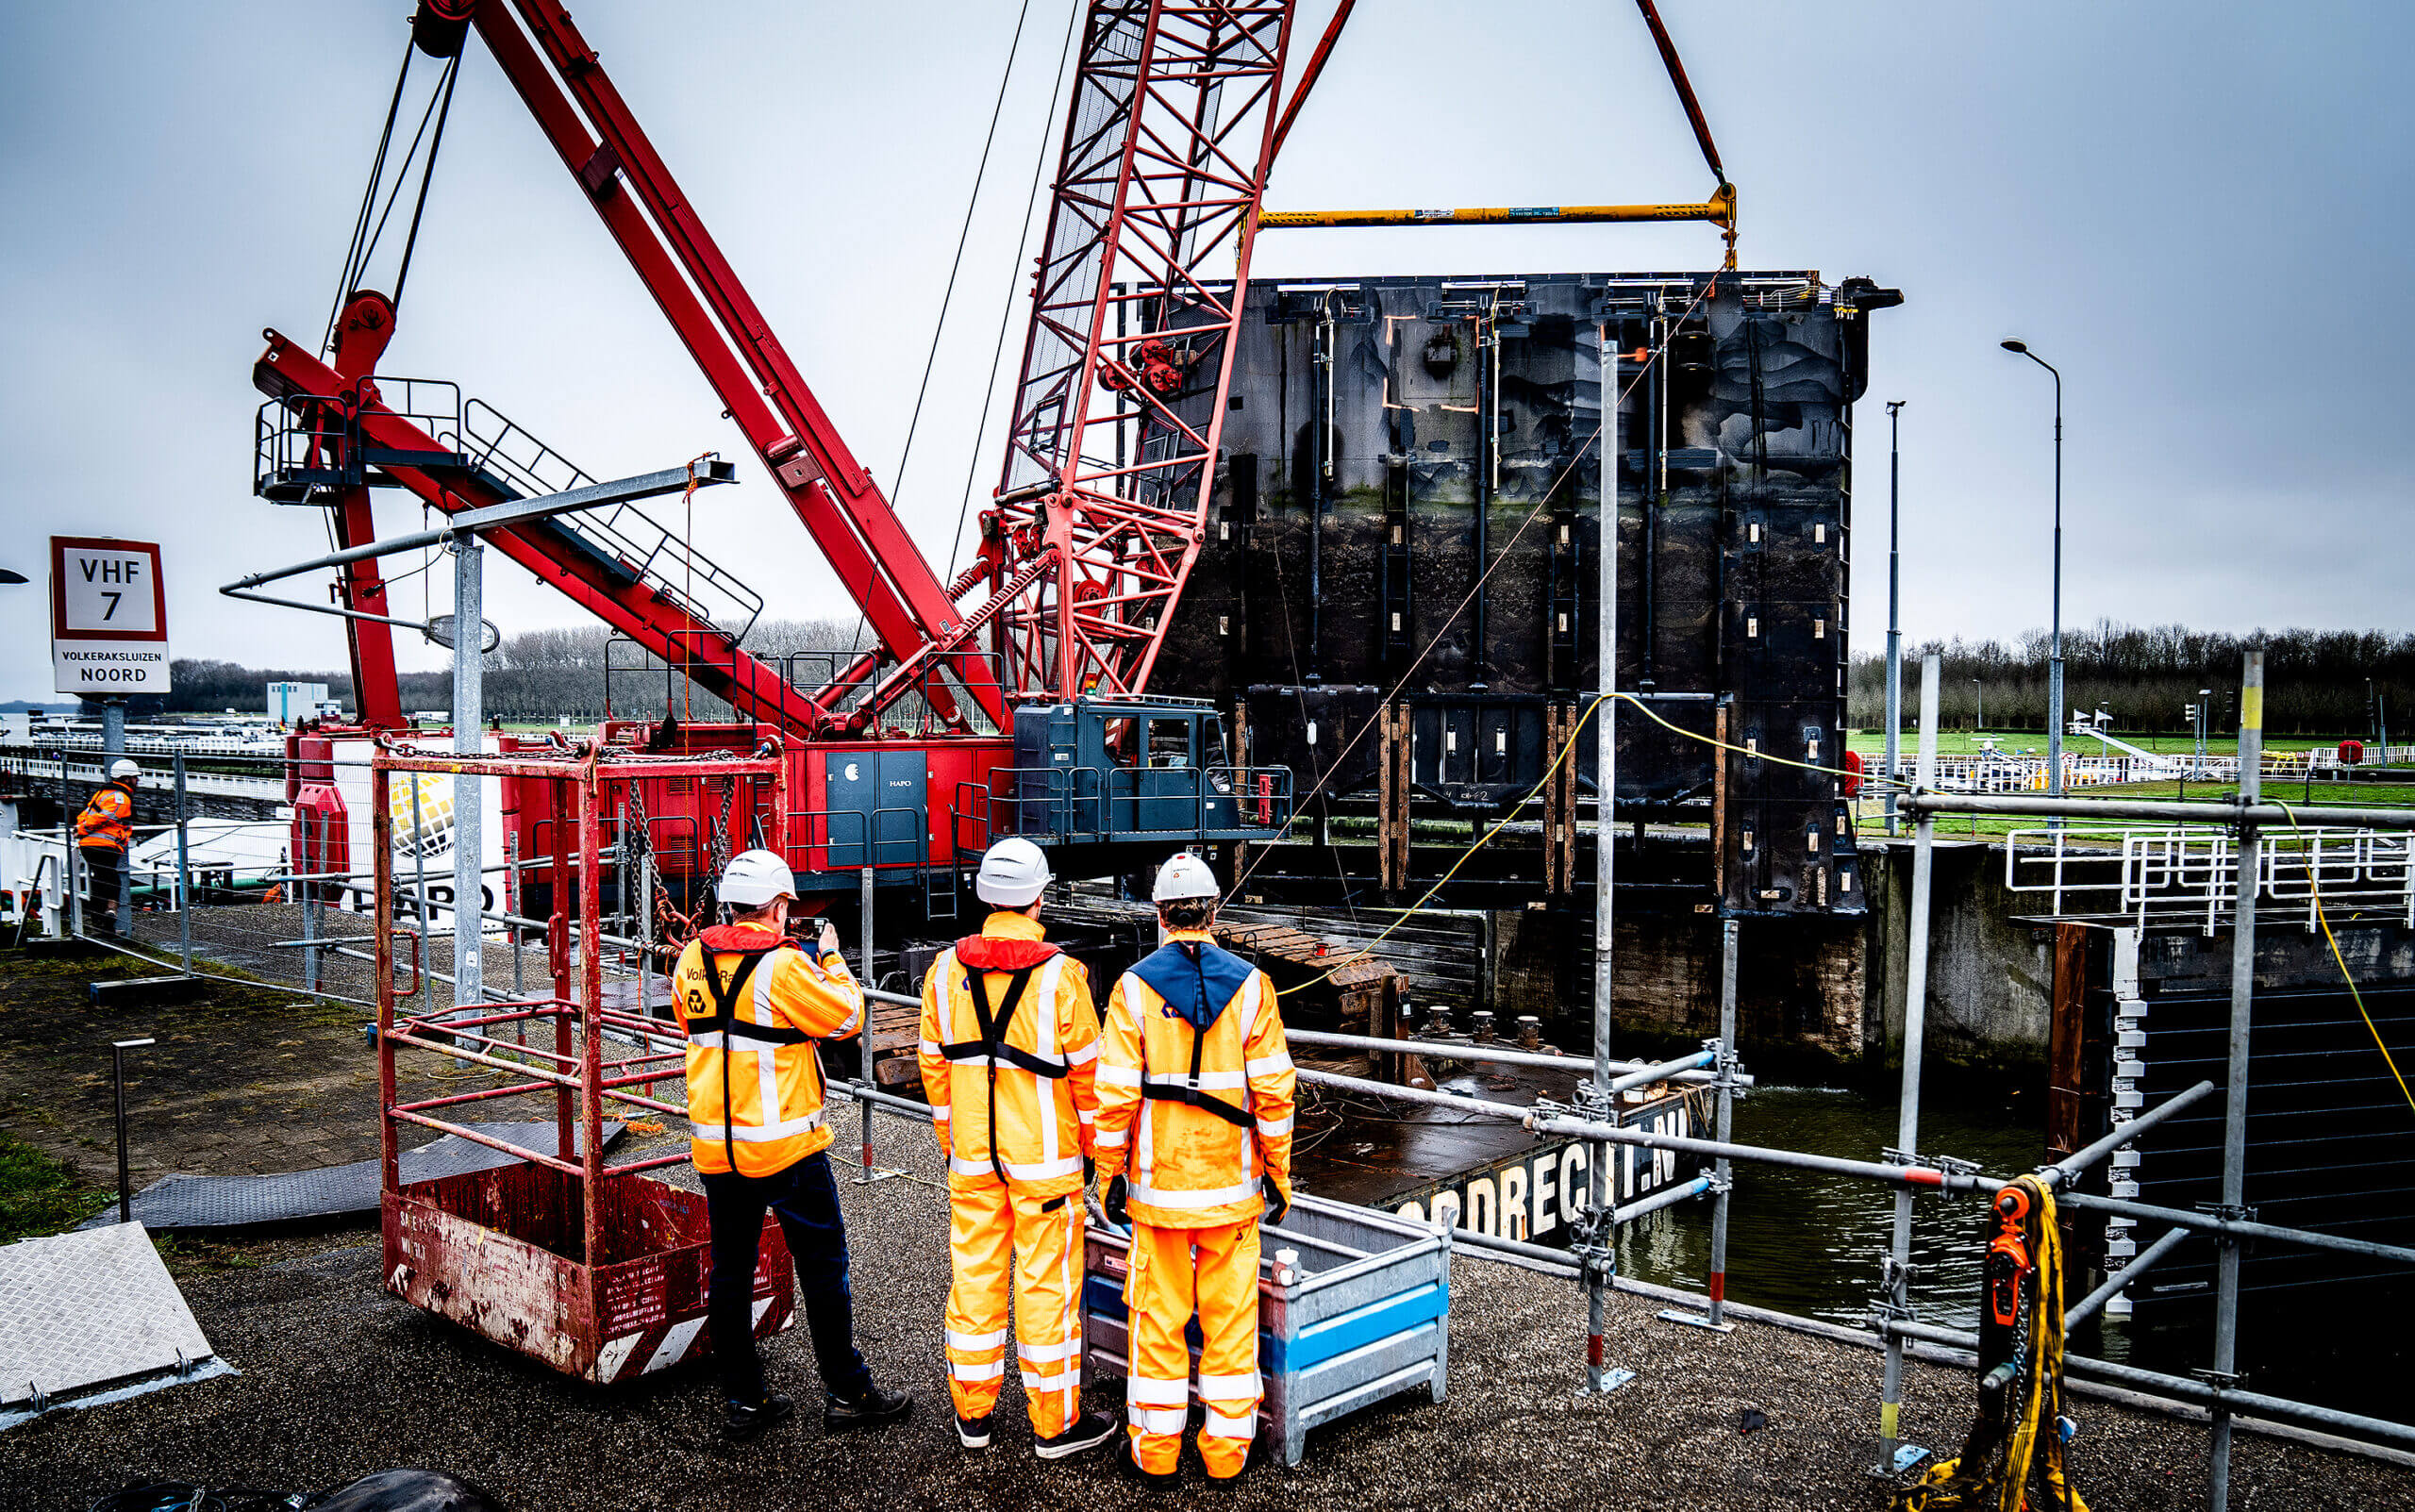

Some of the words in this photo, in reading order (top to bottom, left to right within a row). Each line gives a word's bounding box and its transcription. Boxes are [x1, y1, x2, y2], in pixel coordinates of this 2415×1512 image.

[79, 557, 140, 584] VHF
[101, 591, 122, 621] 7
[62, 652, 161, 661] VOLKERAKSLUIZEN
[81, 668, 146, 681] NOORD
